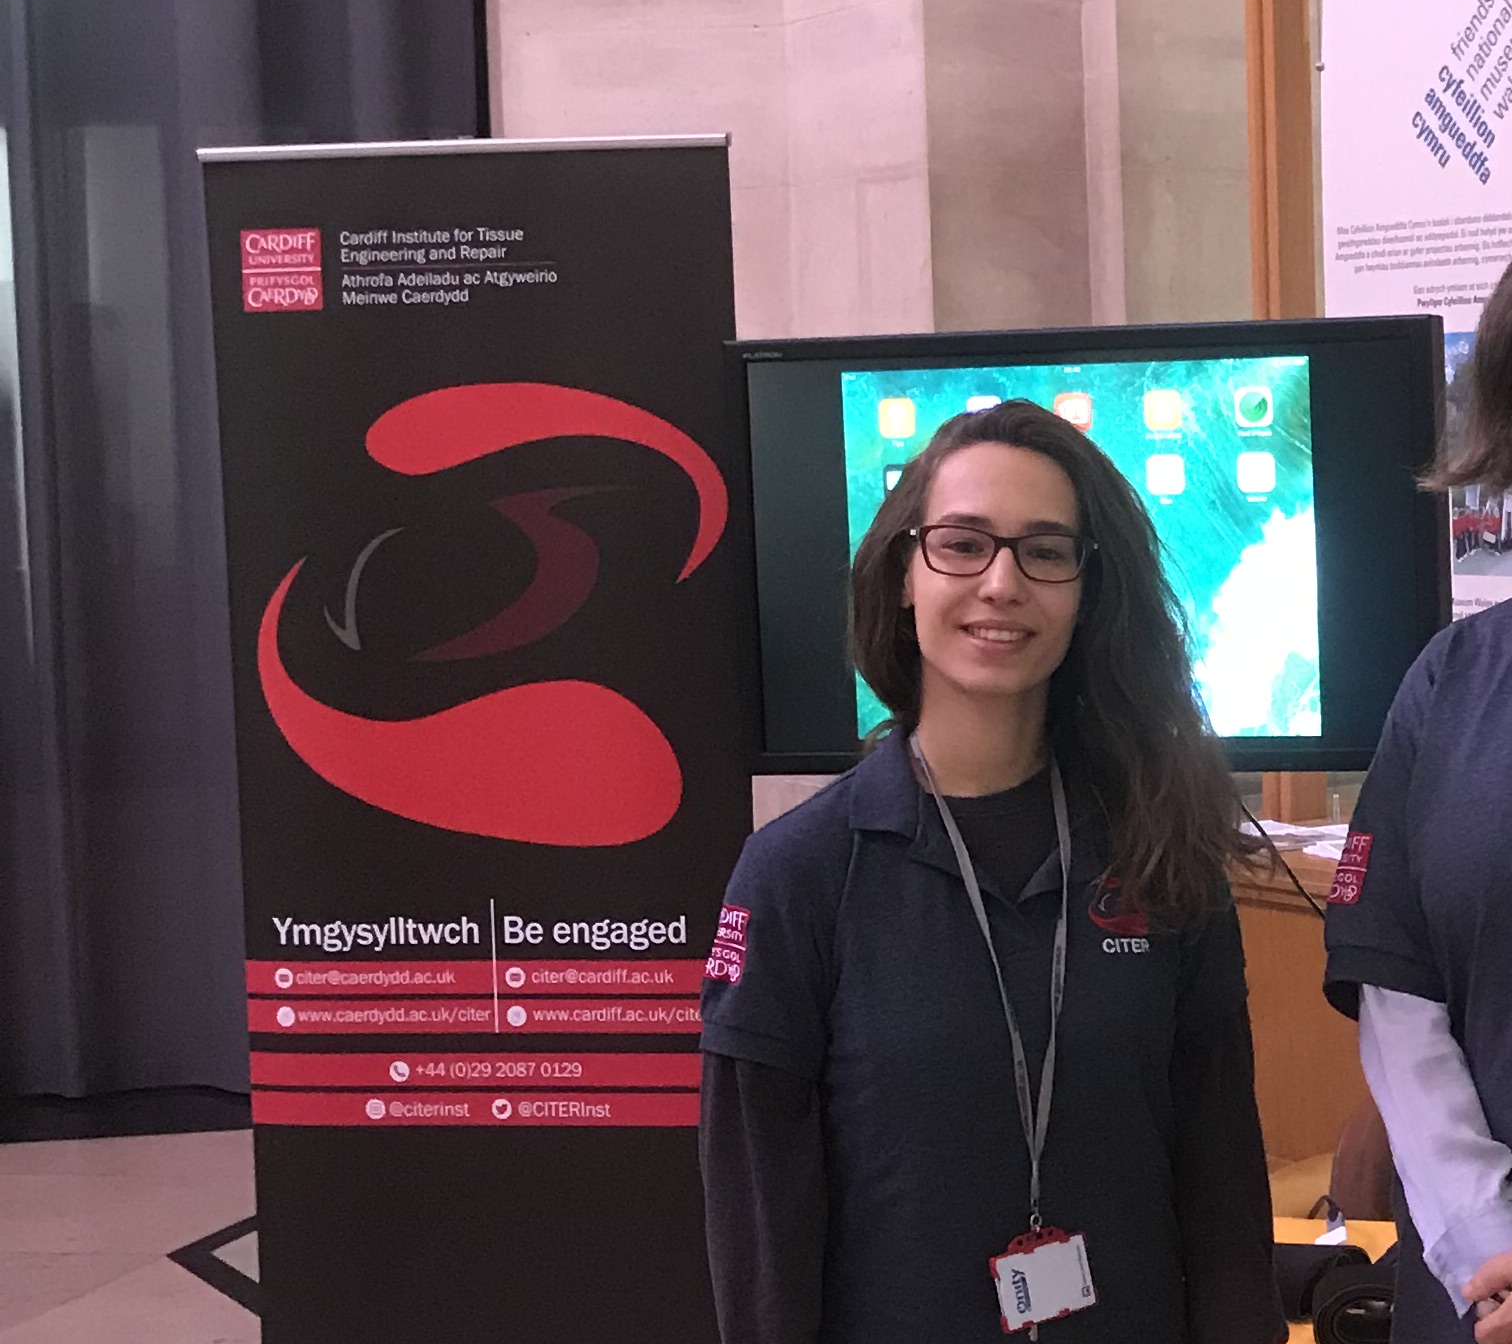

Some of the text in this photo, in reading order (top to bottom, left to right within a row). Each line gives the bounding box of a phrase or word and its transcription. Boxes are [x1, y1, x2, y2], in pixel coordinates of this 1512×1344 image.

[1438, 64, 1496, 149] cyfeillion
[1411, 110, 1451, 169] cymru
[1424, 87, 1491, 185] amgueddfa
[245, 233, 316, 254] CARDIFF
[340, 228, 523, 245] Cardiff Institute for Tissue
[249, 254, 314, 265] UNIVERSITY
[341, 246, 506, 264] Engineering and Repair
[342, 270, 557, 287] Athrofa Adeiladu ac Atgyweirio
[343, 290, 468, 305] Meinwe Caerdydd
[273, 917, 480, 952] Ymgysylltwch
[503, 916, 544, 944] Be
[553, 916, 687, 951] engaged
[1102, 938, 1150, 953] CITER
[296, 968, 456, 987] citer@caerdydd.ac.uk
[531, 969, 674, 985] citer@cardiff.ac.uk
[297, 1006, 491, 1025] www.caerdydd.ac.uk/citer
[532, 1006, 702, 1023] www.cardiff.ac.uk/cite
[415, 1061, 582, 1079] +44 (0)29 2087 0129
[389, 1101, 470, 1117] @citerinst
